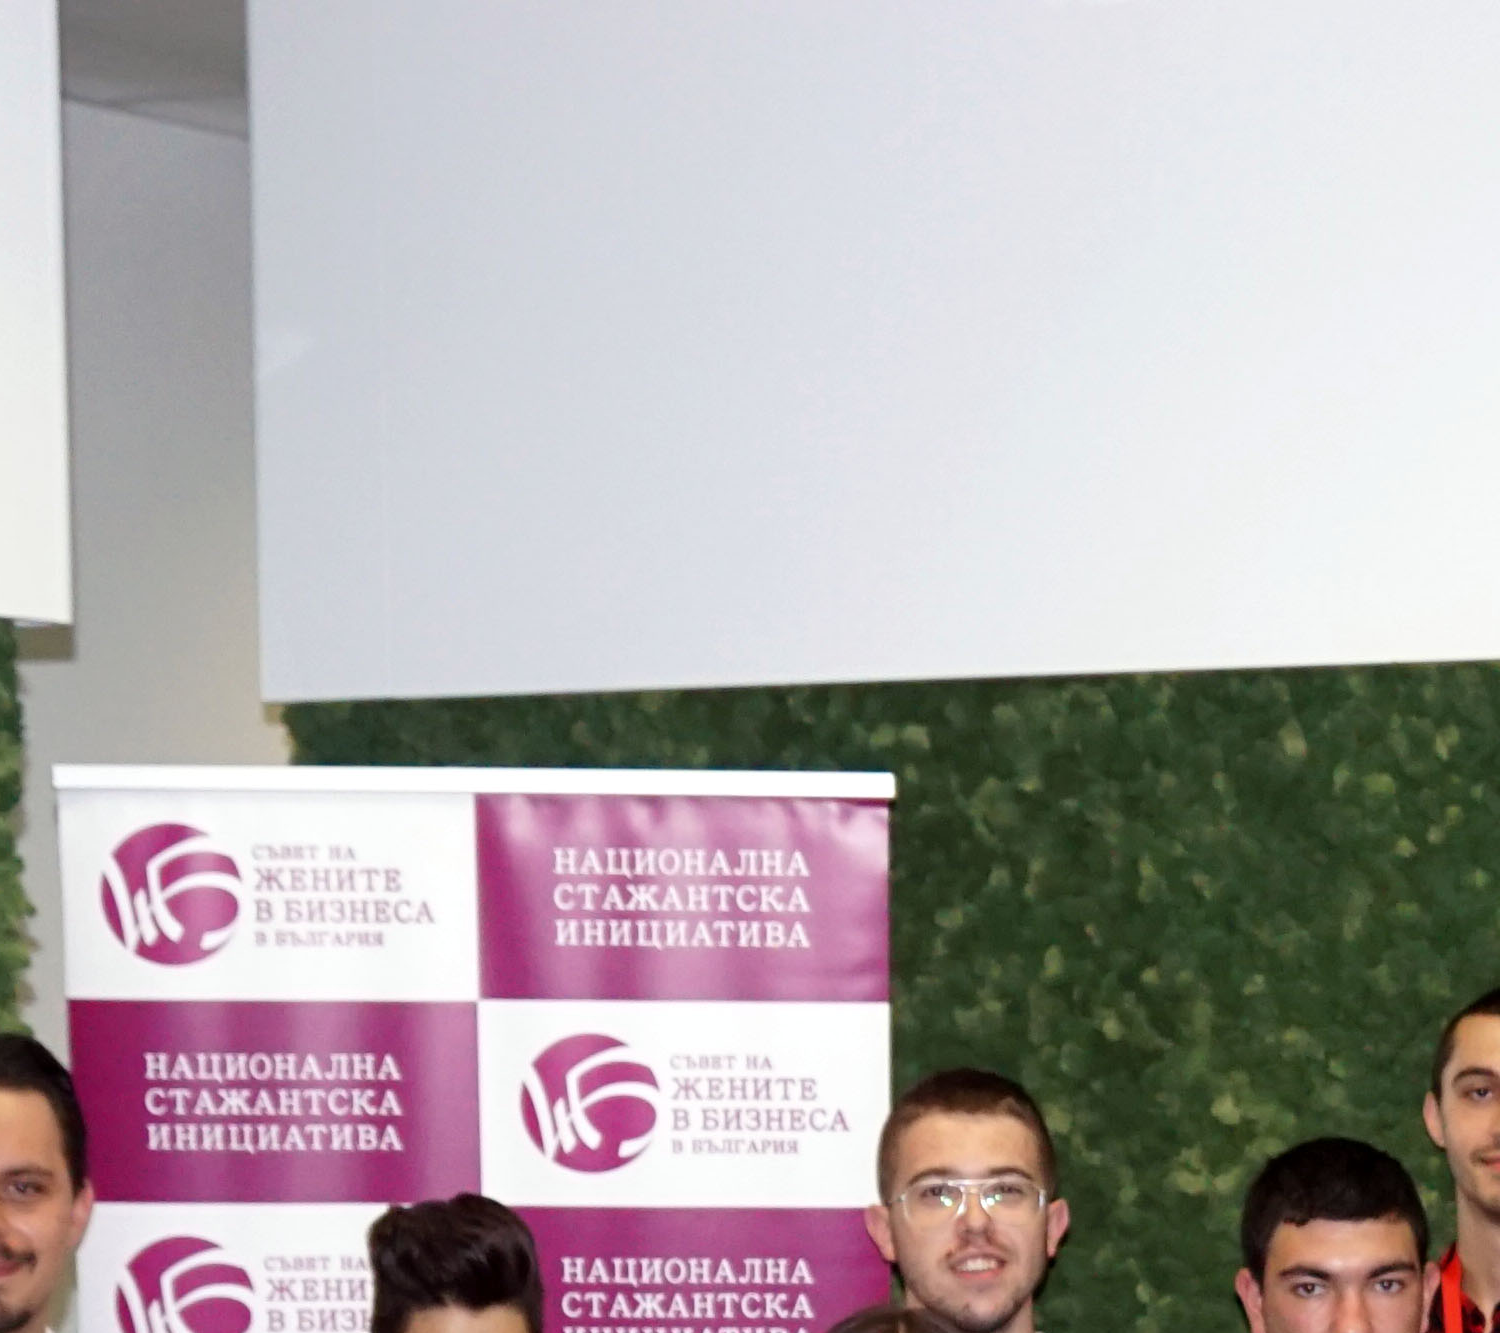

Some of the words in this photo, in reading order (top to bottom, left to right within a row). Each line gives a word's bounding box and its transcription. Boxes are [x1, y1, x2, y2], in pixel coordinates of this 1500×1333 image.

[251, 845, 318, 861] СЪВЕТ
[328, 846, 356, 861] НА
[553, 847, 811, 879] НАЦИОНАЛНА
[253, 868, 403, 893] ЖЕНИТЕ
[553, 883, 811, 912] СТАЖАНТСКА
[254, 900, 274, 923] В
[285, 900, 436, 924] БИЗНЕСА
[255, 931, 268, 947] В
[275, 931, 385, 947] БЪЛГАРИЯ
[554, 918, 811, 950] ИНИЦИАТИВА
[143, 1052, 403, 1083] НАЦИОНАЛНА
[669, 1055, 737, 1071] СЪВЕТ
[745, 1055, 773, 1071] НА
[144, 1087, 403, 1117] СТАЖАНТСКА
[672, 1078, 819, 1102] ЖЕНИТЕ
[672, 1108, 690, 1132] В
[702, 1108, 850, 1132] БИЗНЕСА
[146, 1123, 404, 1154] ИНИЦИАТИВА
[672, 1139, 684, 1155] В
[692, 1139, 799, 1155] БЪЛГАРИЯ
[263, 1255, 331, 1272] СЪВЕТ
[340, 1255, 368, 1272] НА
[561, 1257, 815, 1288] НАЦИОНАЛНА
[561, 1292, 815, 1319] СТАЖАНТСКА
[267, 1308, 285, 1333] В
